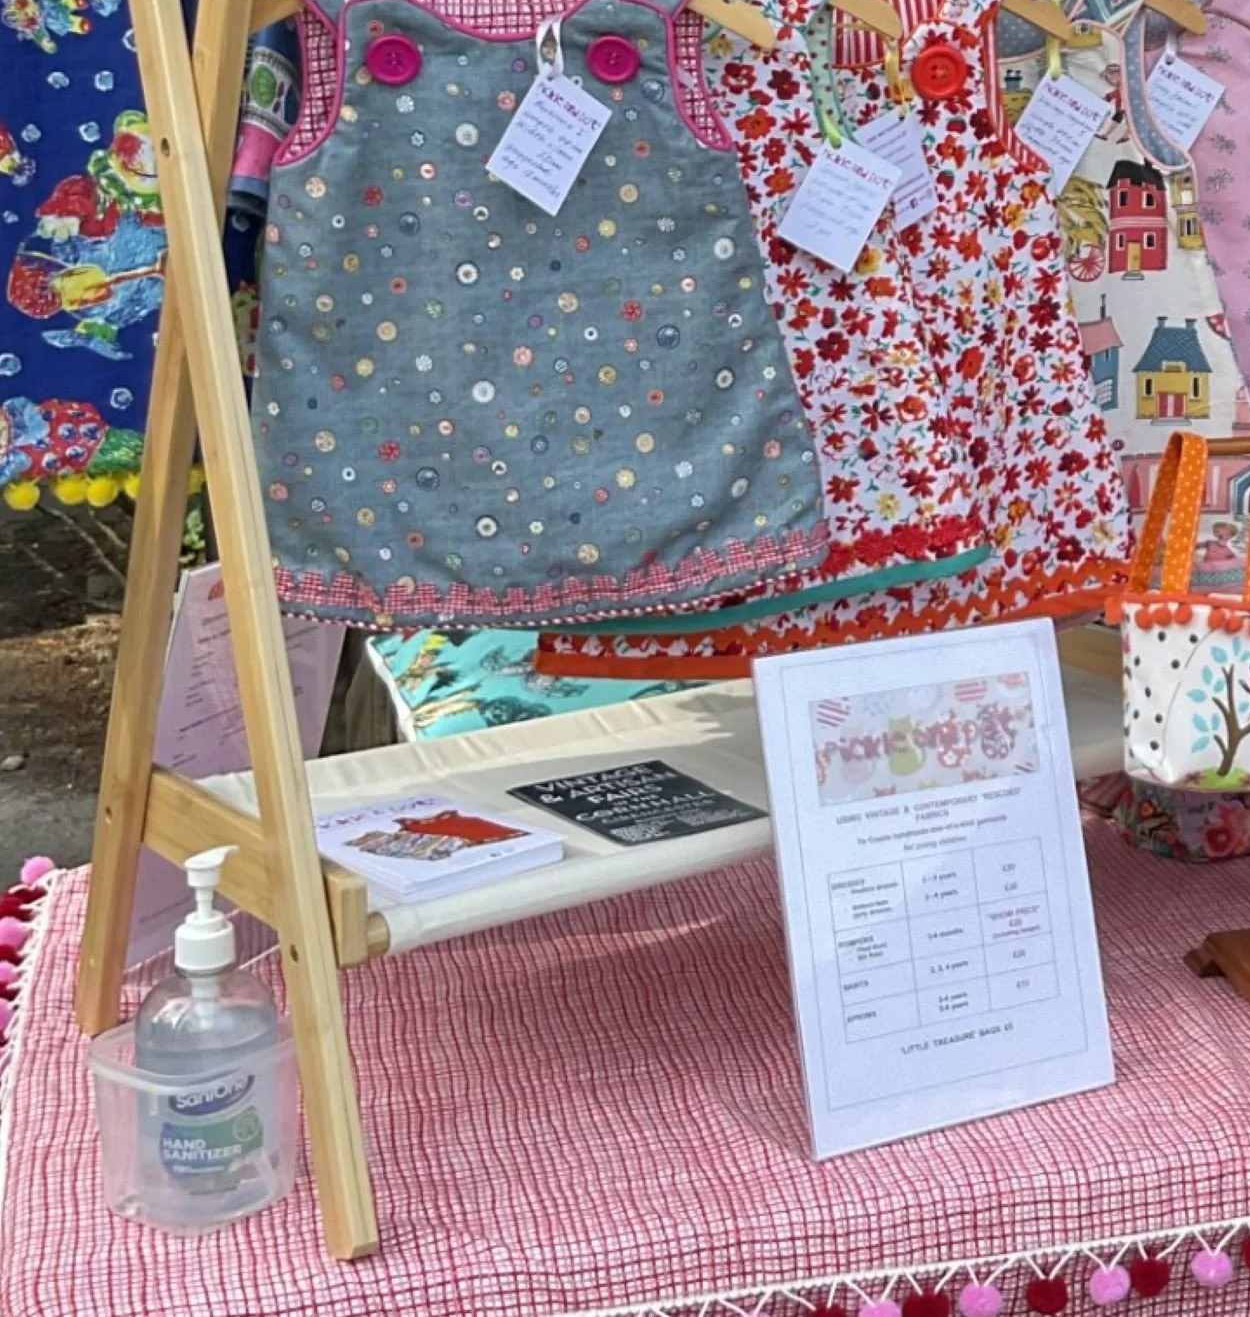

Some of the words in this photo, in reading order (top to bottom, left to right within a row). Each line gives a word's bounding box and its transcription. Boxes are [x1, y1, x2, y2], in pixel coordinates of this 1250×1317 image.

[535, 763, 653, 792] VINTAGE
[540, 792, 564, 804] &
[570, 771, 677, 799] ARTISAN
[587, 784, 663, 804] FAIRS
[163, 1138, 206, 1150] HAND
[163, 1144, 242, 1161] SANITIZER
